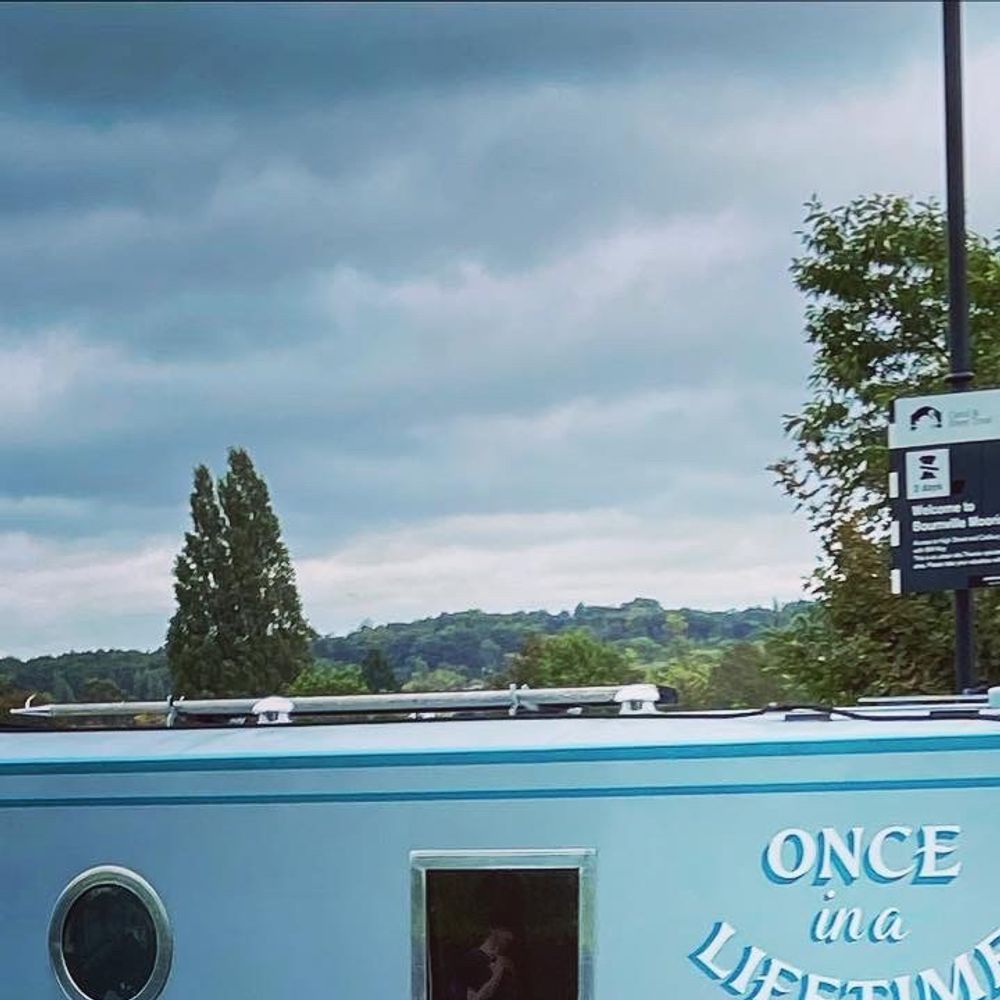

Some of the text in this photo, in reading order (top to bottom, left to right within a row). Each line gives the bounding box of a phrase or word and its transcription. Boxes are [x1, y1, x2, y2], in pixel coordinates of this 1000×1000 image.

[911, 502, 976, 516] Welcome to
[762, 824, 963, 886] ONCE
[810, 889, 909, 943] in a
